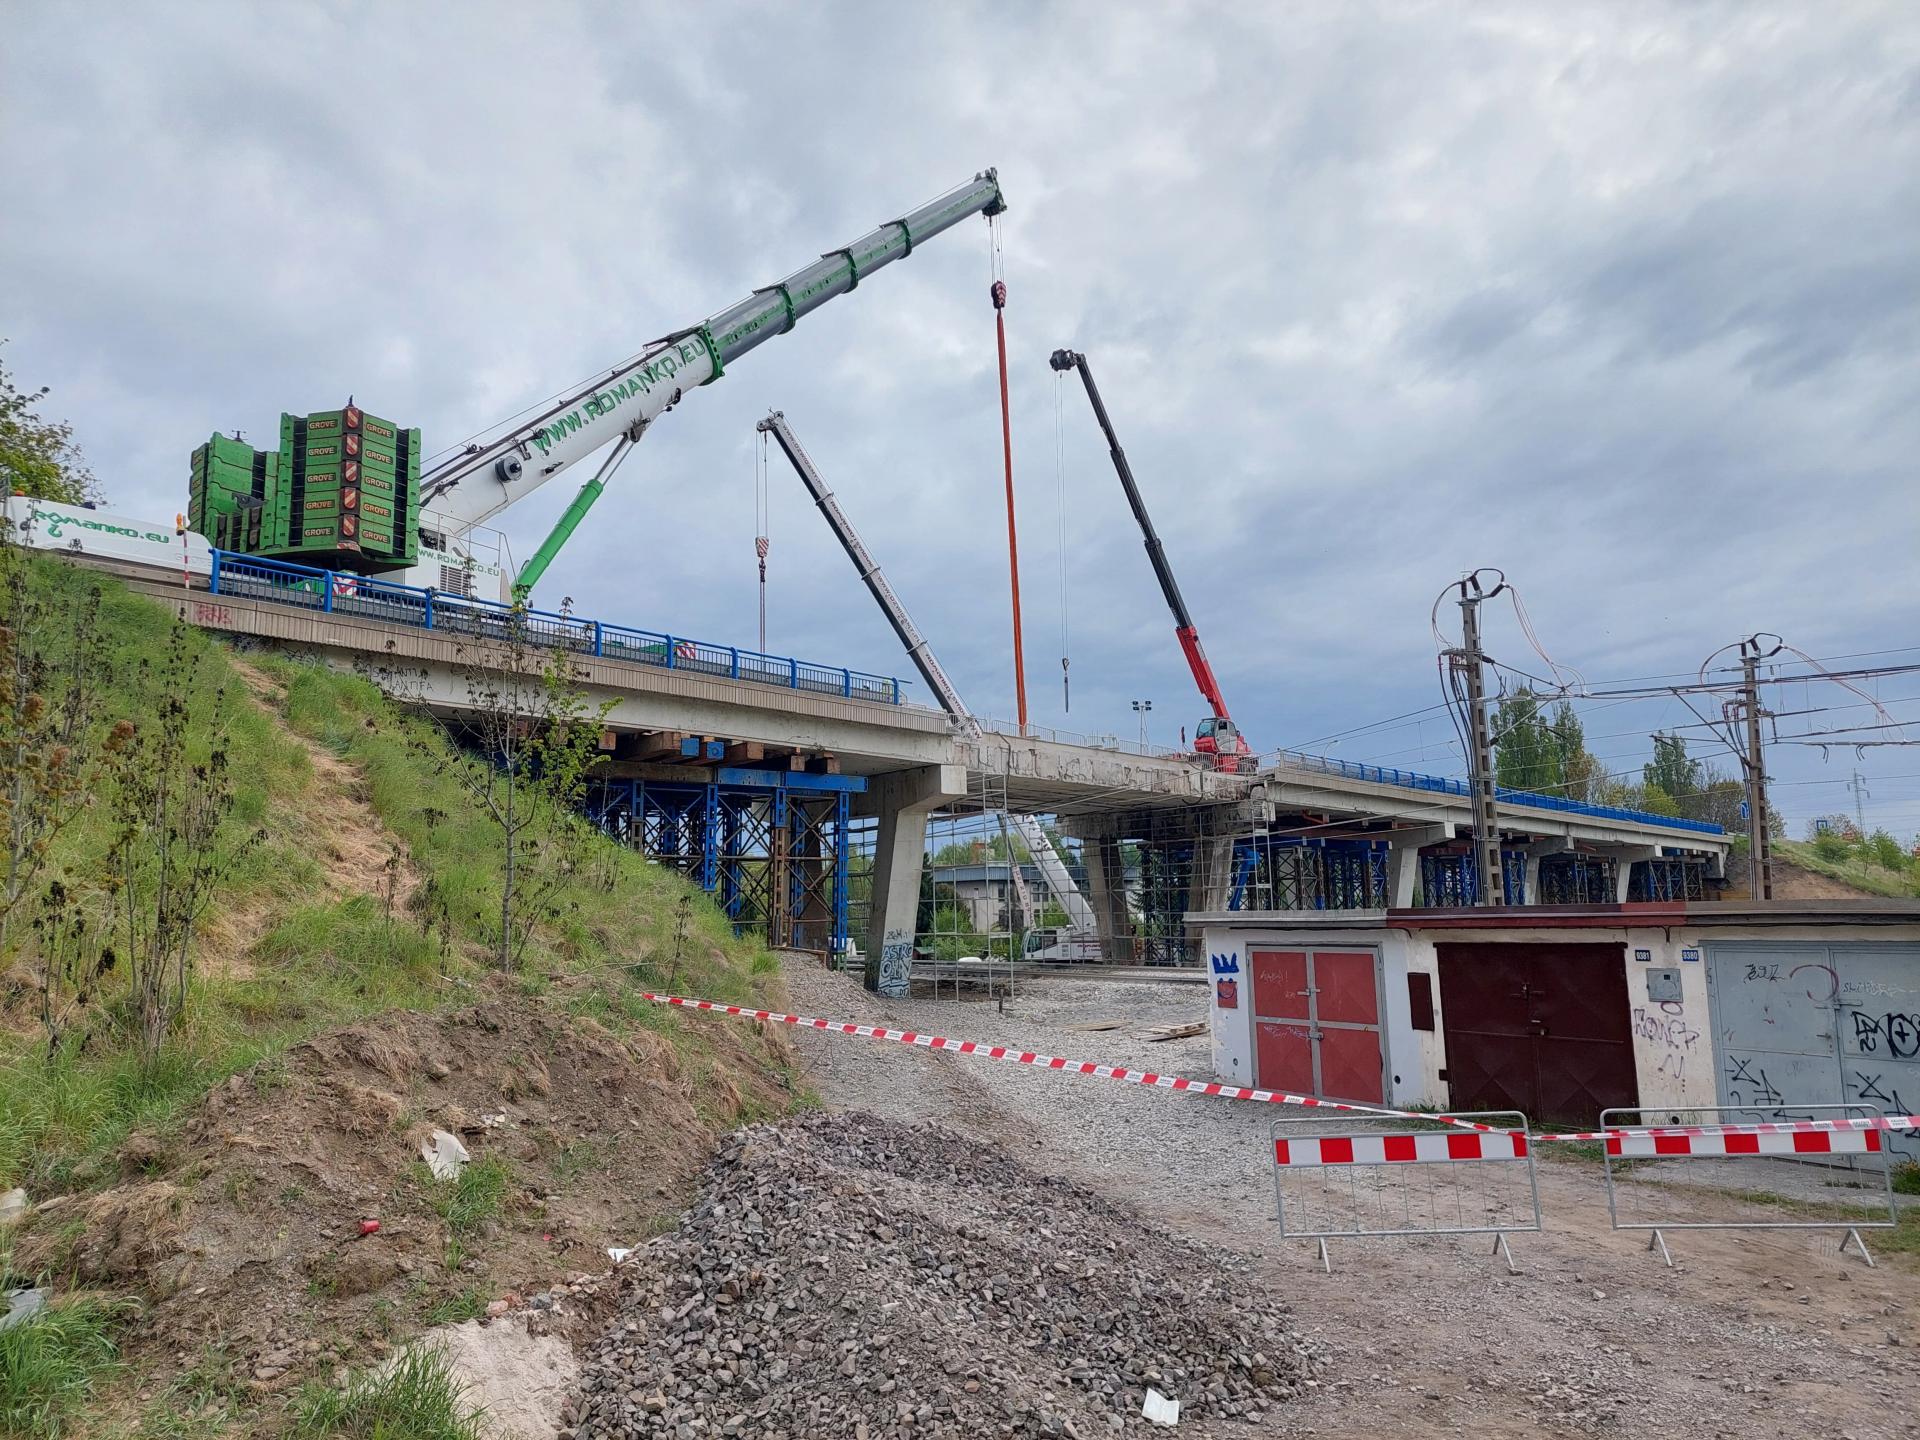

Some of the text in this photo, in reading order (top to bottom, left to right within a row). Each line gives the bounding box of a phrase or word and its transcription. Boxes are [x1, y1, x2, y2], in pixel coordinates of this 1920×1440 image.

[309, 420, 336, 430] GROVE
[366, 423, 392, 437] GROVE
[308, 446, 335, 456] GROVE
[365, 450, 391, 464] GROVE
[307, 473, 334, 483] GROVE
[365, 476, 390, 490] GROVE
[306, 500, 333, 510] GROVE
[363, 503, 389, 517] GROVE
[305, 527, 331, 537] GROVE
[362, 529, 388, 543] GROVE
